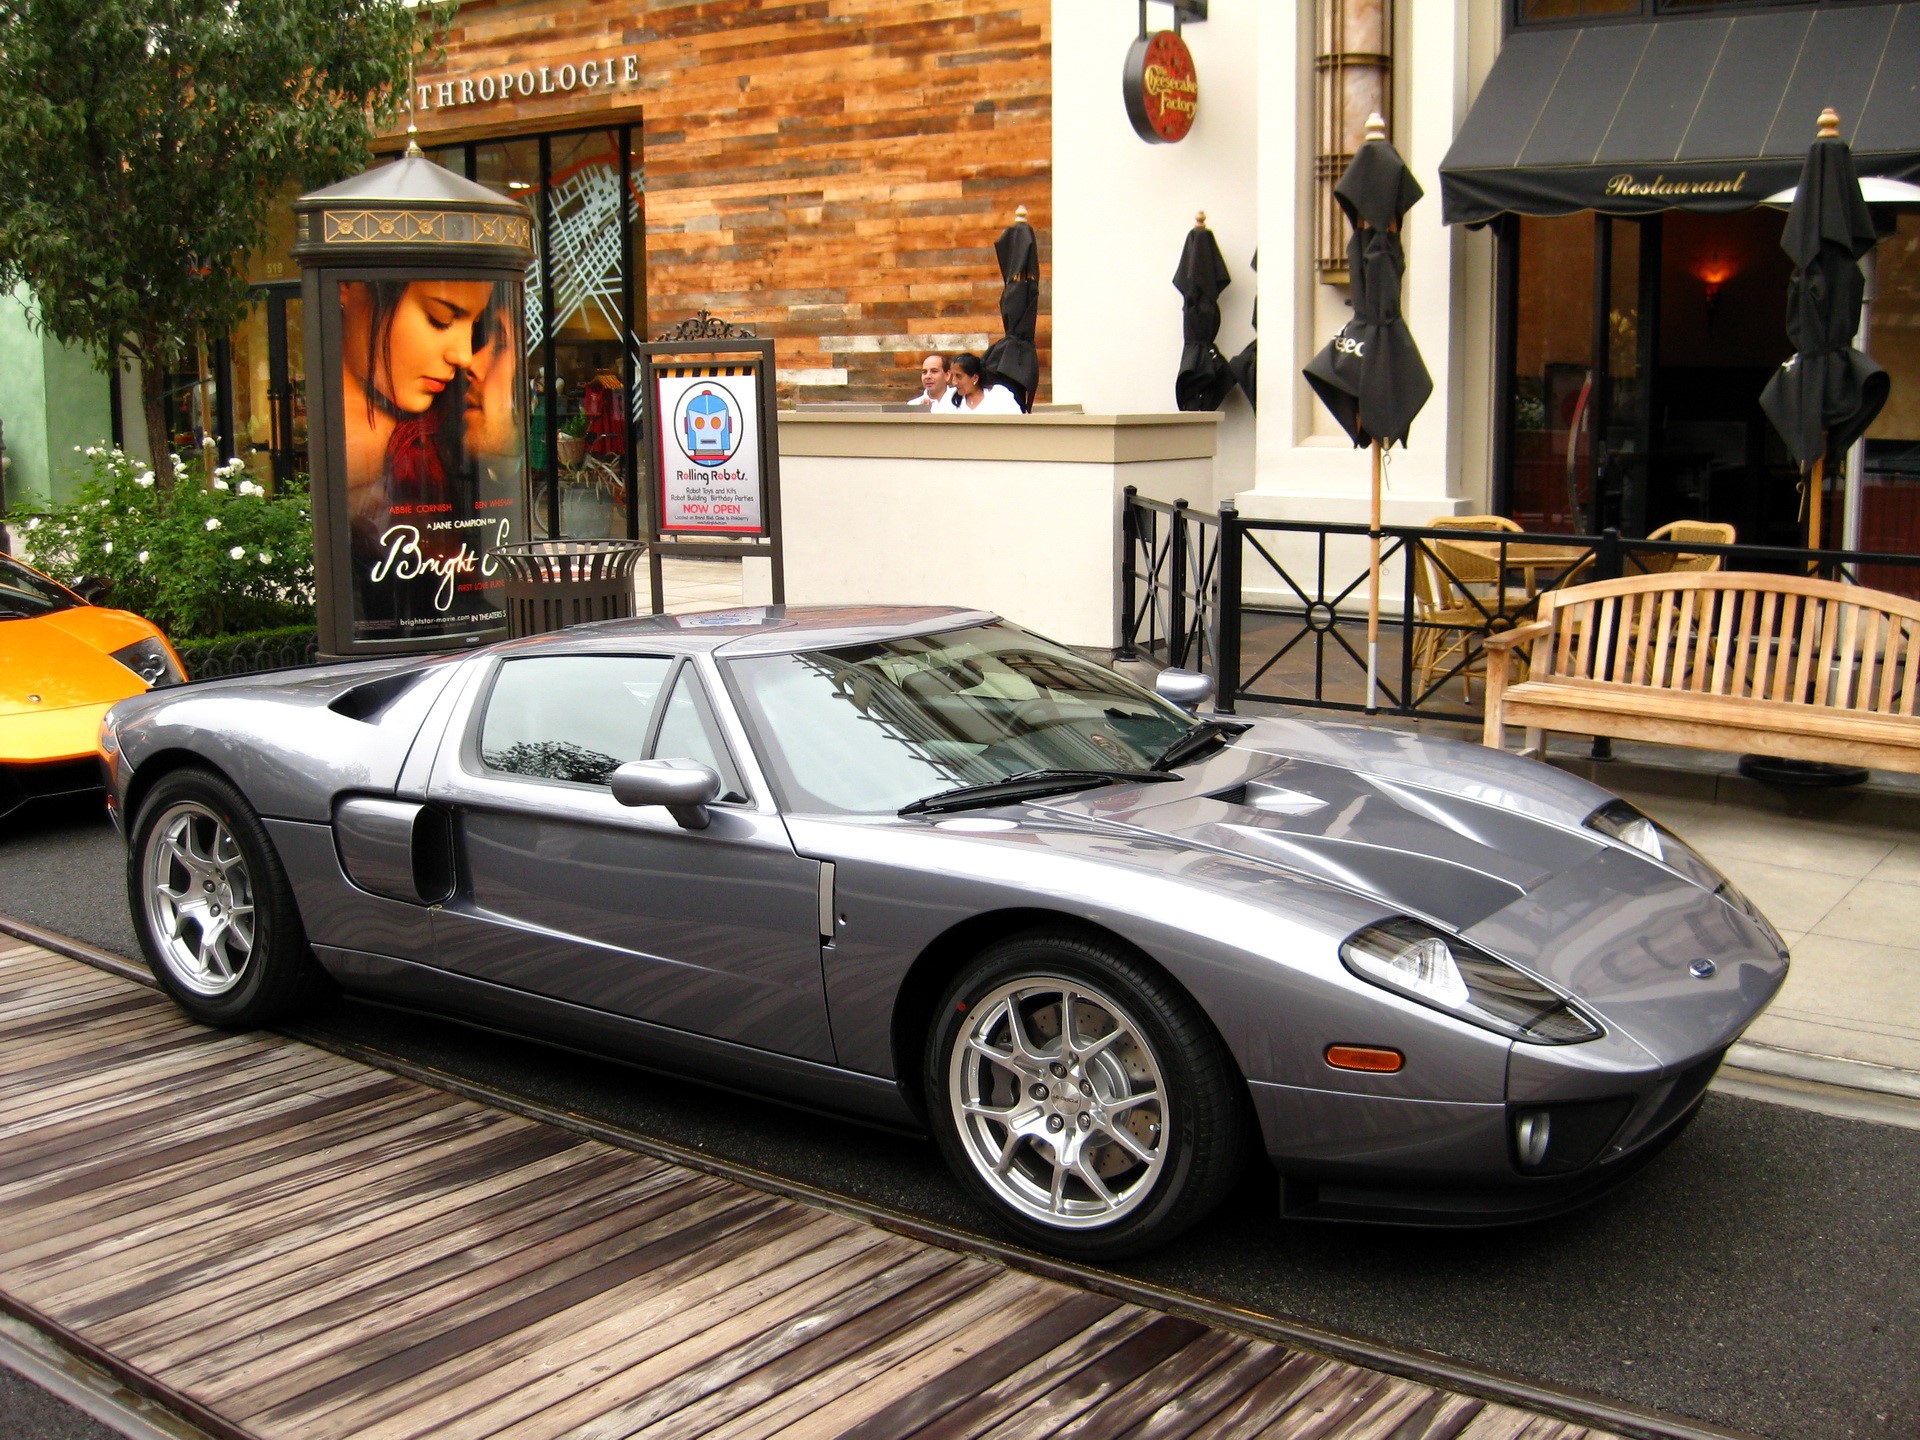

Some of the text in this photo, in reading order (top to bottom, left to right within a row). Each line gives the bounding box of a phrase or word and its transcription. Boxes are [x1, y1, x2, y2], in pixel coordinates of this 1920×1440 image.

[381, 54, 640, 115] THROPOLOGIE
[1605, 171, 1748, 196] Restaurant
[267, 262, 283, 274] 519
[677, 469, 746, 485] Rolling Robots
[702, 487, 714, 495] Toys
[687, 495, 708, 503] Building
[389, 505, 413, 514] ABBIE
[416, 503, 453, 513] CORNISH
[474, 501, 488, 510] BEN
[683, 504, 741, 514] NOW OPEN
[433, 521, 453, 531] JANE
[454, 518, 487, 528] CAMPION
[371, 525, 479, 611] Bright
[457, 584, 474, 592] FIRST
[474, 582, 490, 590] LOVE
[400, 614, 471, 627] brightstar-movie.com
[471, 614, 480, 622] IN
[479, 611, 502, 621] THEATERS
